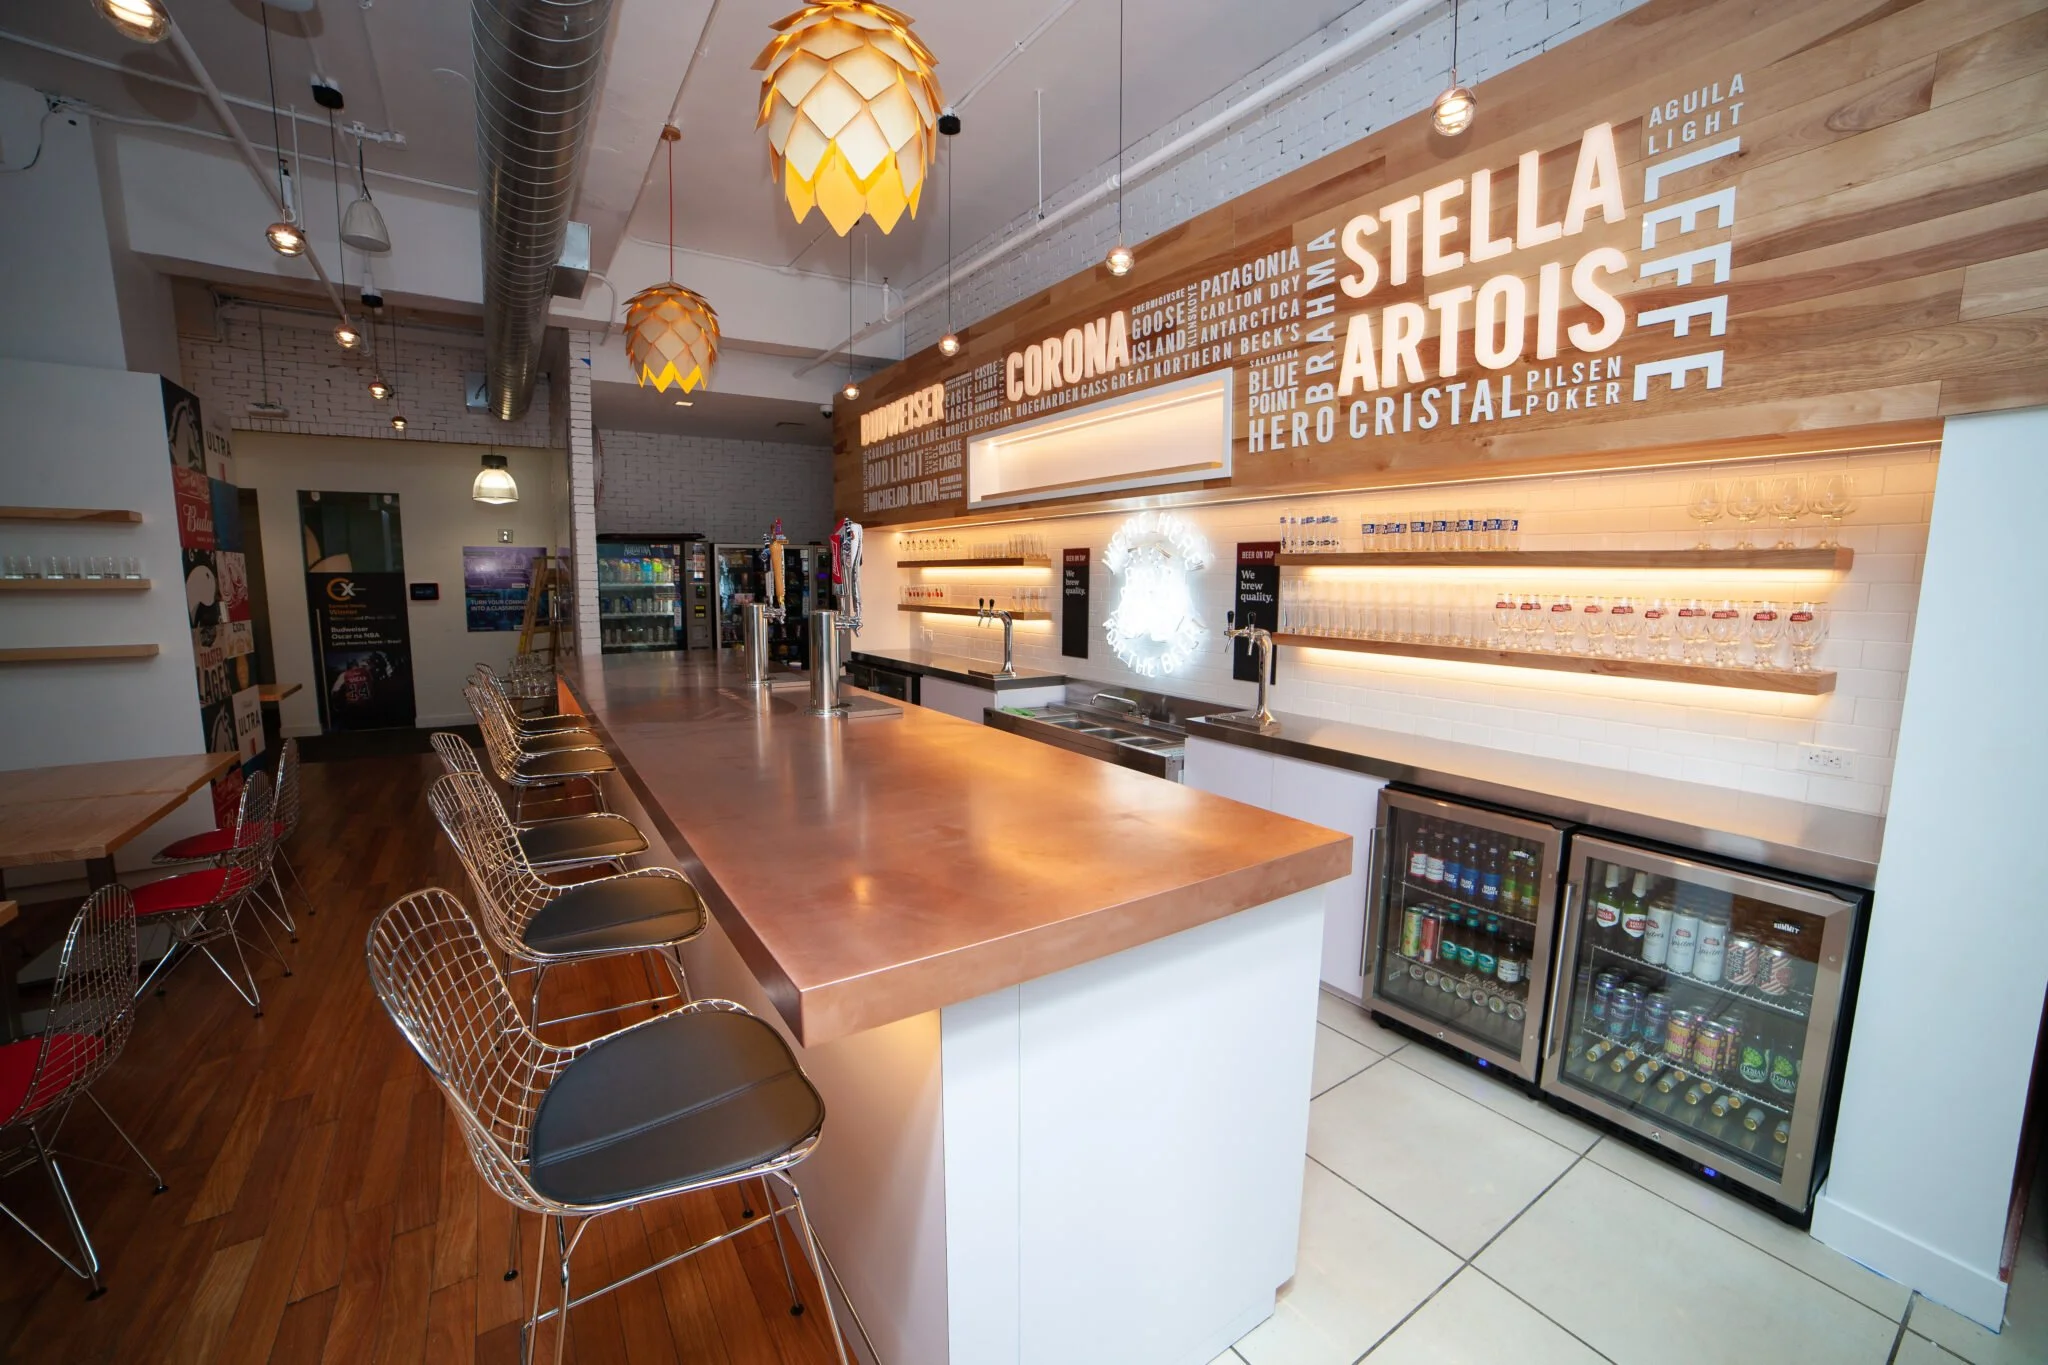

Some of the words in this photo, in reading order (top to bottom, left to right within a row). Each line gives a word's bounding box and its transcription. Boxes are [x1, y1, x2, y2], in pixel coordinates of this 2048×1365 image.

[1648, 73, 1745, 129] AGUILA
[1648, 102, 1745, 156] LIGHT
[1340, 121, 1626, 300] STELLA
[1200, 245, 1300, 301] PATAGONIA
[1633, 136, 1741, 402] LEFFE
[1187, 282, 1198, 349] KLINSKOYE
[1200, 287, 1262, 321] CARLTON
[1270, 275, 1300, 300] DRY
[1304, 228, 1337, 405] BRAHMA
[1131, 301, 1185, 341] GOOSE
[1200, 298, 1300, 344] ANTARCTICA
[1337, 247, 1627, 397] ARTOIS
[1006, 310, 1130, 402] CORONA
[1131, 329, 1186, 365] ISLAND
[974, 406, 1013, 429] ESPECIAL
[1016, 384, 1079, 418] HOEGAARDEN
[1081, 378, 1108, 400] CASS
[1111, 365, 1150, 391] GREAT
[1153, 341, 1233, 380] NORTHERN
[1240, 323, 1300, 356] BECK'S
[974, 374, 998, 394] LIGHT
[1248, 361, 1299, 395] BLUE
[1526, 355, 1623, 392] PILSEN
[861, 383, 945, 447] BUDWEISER
[945, 384, 973, 408] EAGLE
[945, 401, 974, 423] LAGER
[1248, 386, 1299, 417] POINT
[1248, 406, 1334, 454] HERO
[1349, 374, 1526, 440] CRISTAL
[1525, 382, 1620, 416] POKER
[205, 430, 232, 460] ULTRA
[868, 459, 889, 488] BUD
[890, 449, 924, 483] LIGHT
[910, 479, 940, 505] ULTRA
[1241, 551, 1255, 559] BEER
[1255, 551, 1263, 559] ON
[1264, 550, 1274, 559] TAP
[1240, 580, 1264, 590] brew
[1241, 569, 1256, 580] We
[1240, 591, 1274, 604] quality.
[237, 709, 261, 737] ULTRA
[1773, 922, 1800, 934] SUMMIT
